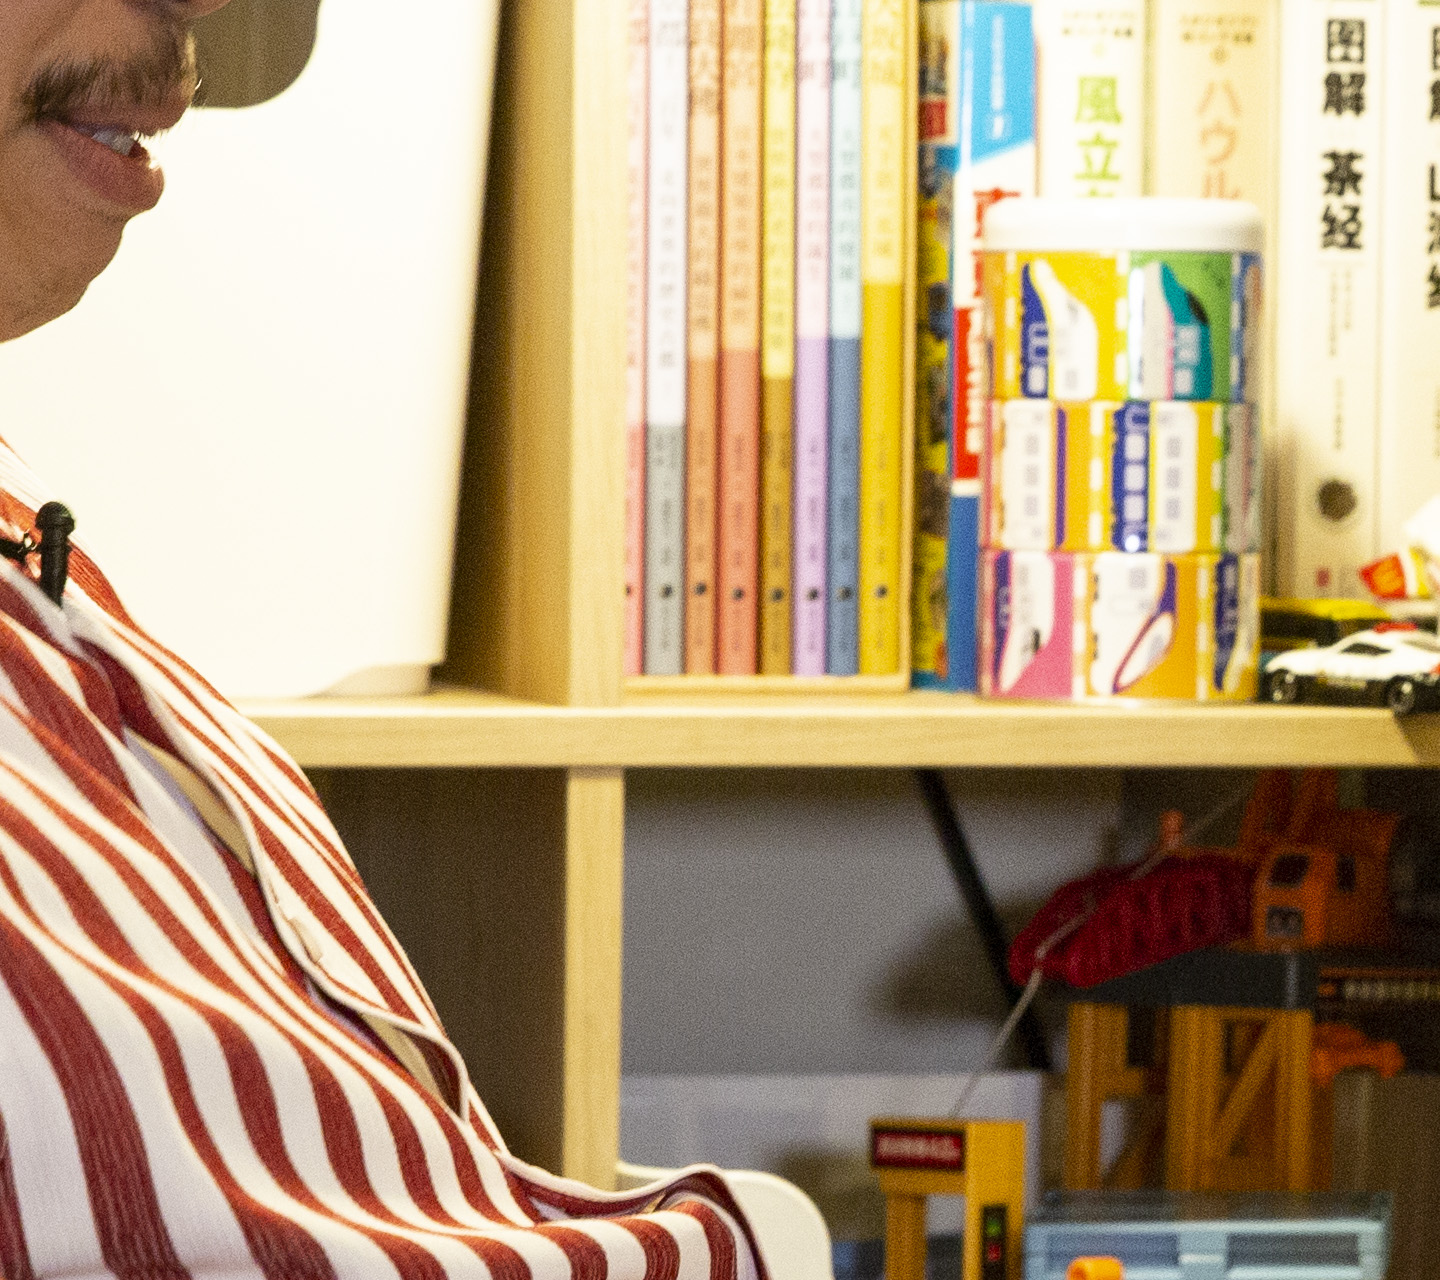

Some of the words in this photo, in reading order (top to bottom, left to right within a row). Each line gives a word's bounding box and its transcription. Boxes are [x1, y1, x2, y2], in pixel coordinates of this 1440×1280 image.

[1323, 18, 1366, 117] 图解
[1073, 76, 1123, 198] 風立
[1321, 149, 1365, 251] 茶经
